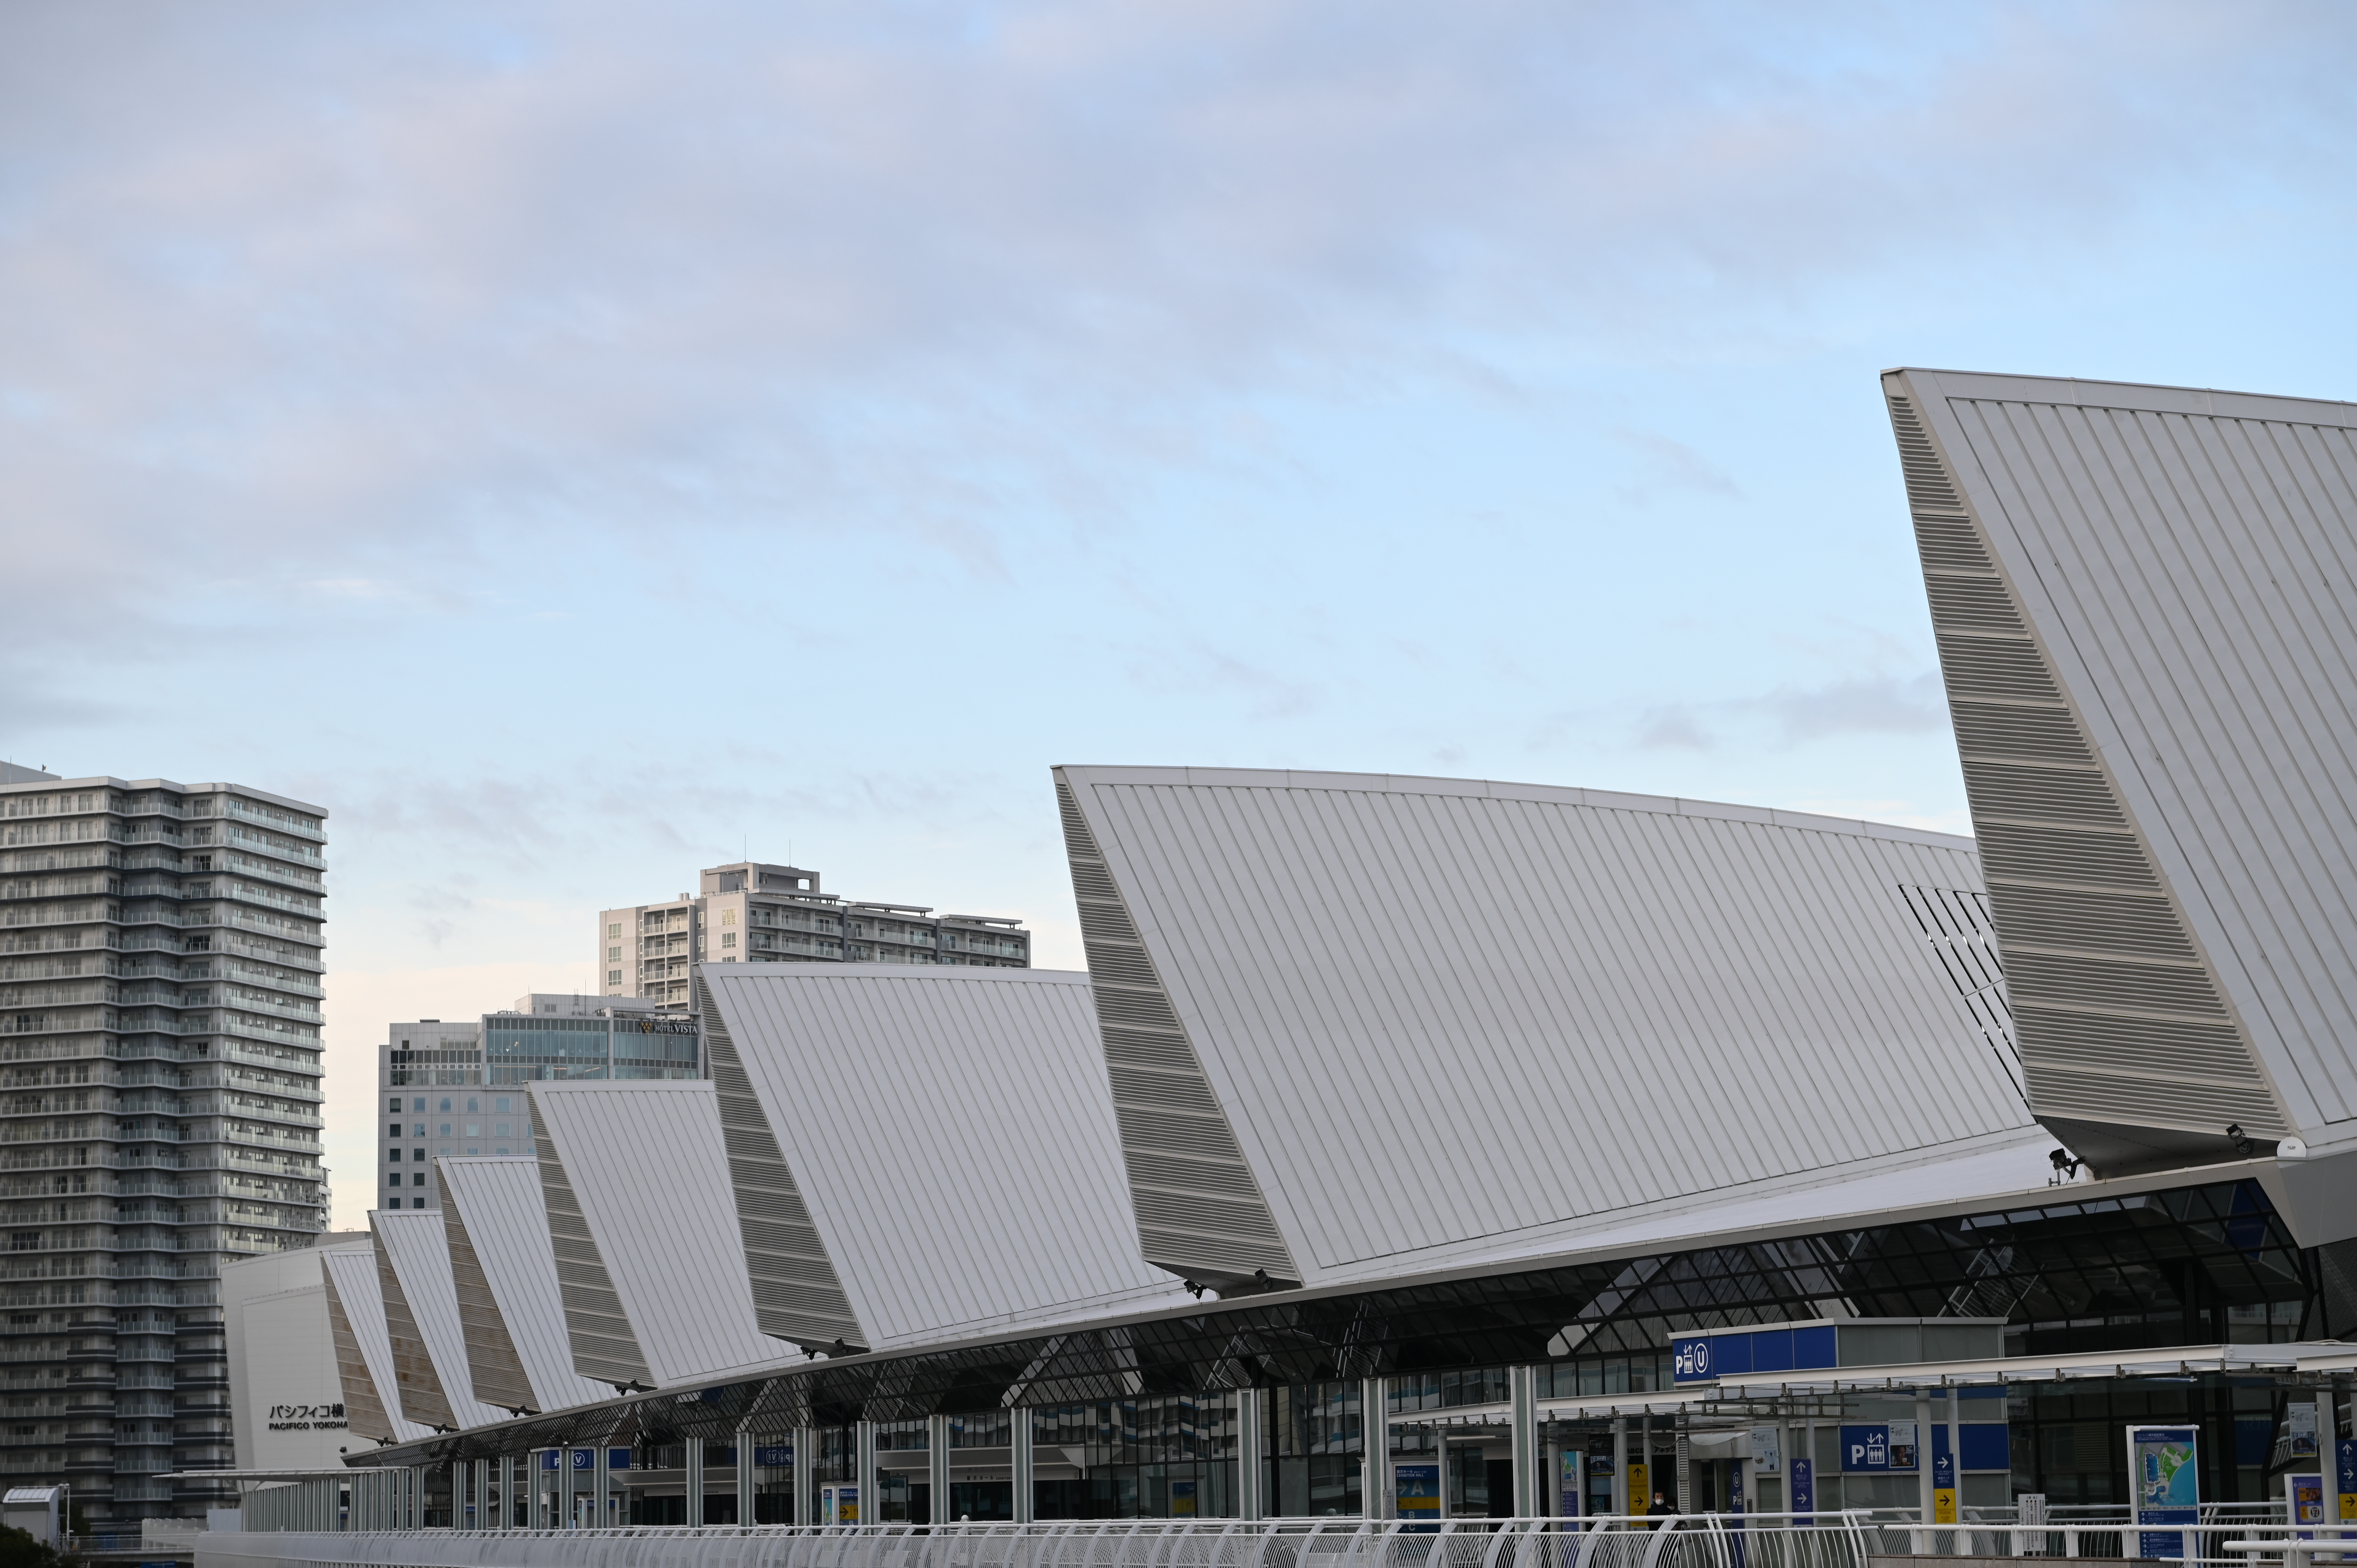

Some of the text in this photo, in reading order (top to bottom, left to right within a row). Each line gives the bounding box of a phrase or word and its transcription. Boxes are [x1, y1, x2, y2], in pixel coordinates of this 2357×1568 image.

[674, 1024, 697, 1033] VISTA
[1676, 1351, 1705, 1374] P U
[269, 1403, 346, 1418] パシフィコ横
[269, 1422, 309, 1430] PACIFICO
[1852, 1445, 1865, 1464] P
[1411, 1480, 1424, 1495] A
[1733, 1496, 1737, 1505] P
